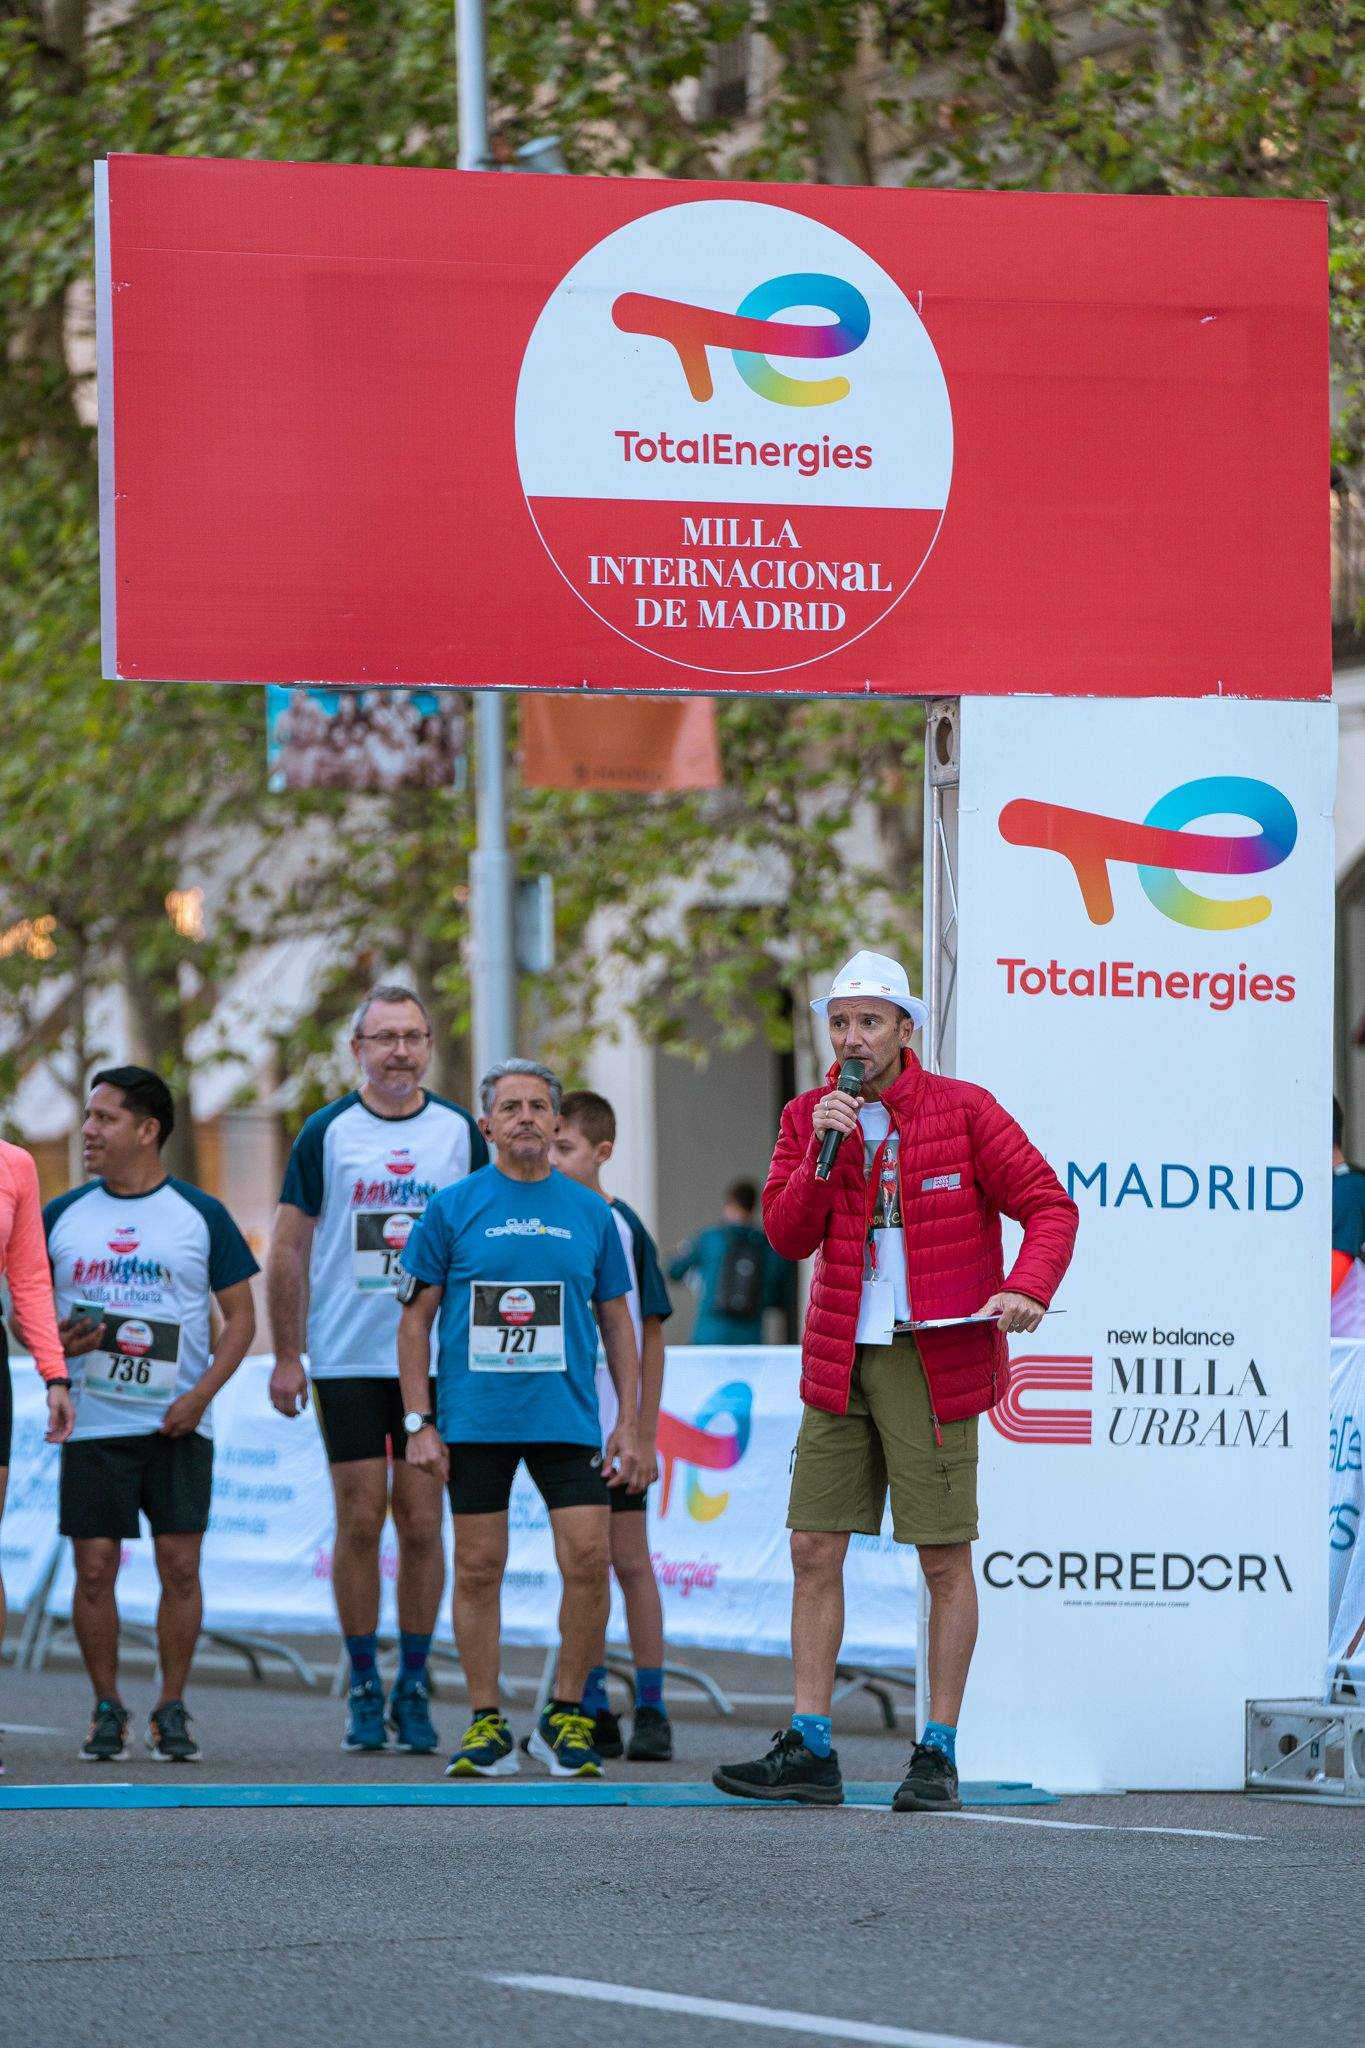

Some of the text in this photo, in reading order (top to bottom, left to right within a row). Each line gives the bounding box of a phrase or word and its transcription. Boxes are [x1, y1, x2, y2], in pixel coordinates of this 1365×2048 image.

[614, 430, 873, 477] TotalEnergies
[681, 517, 802, 549] MILLA
[635, 598, 847, 632] DE MADRID
[996, 958, 1297, 1012] TotalEnergies
[1067, 1161, 1305, 1212] MADRID
[497, 1327, 537, 1353] 727
[1106, 1327, 1235, 1348] new balance
[108, 1353, 152, 1384] 736
[1107, 1356, 1272, 1398] MILLA
[1108, 1406, 1294, 1448] URBANA
